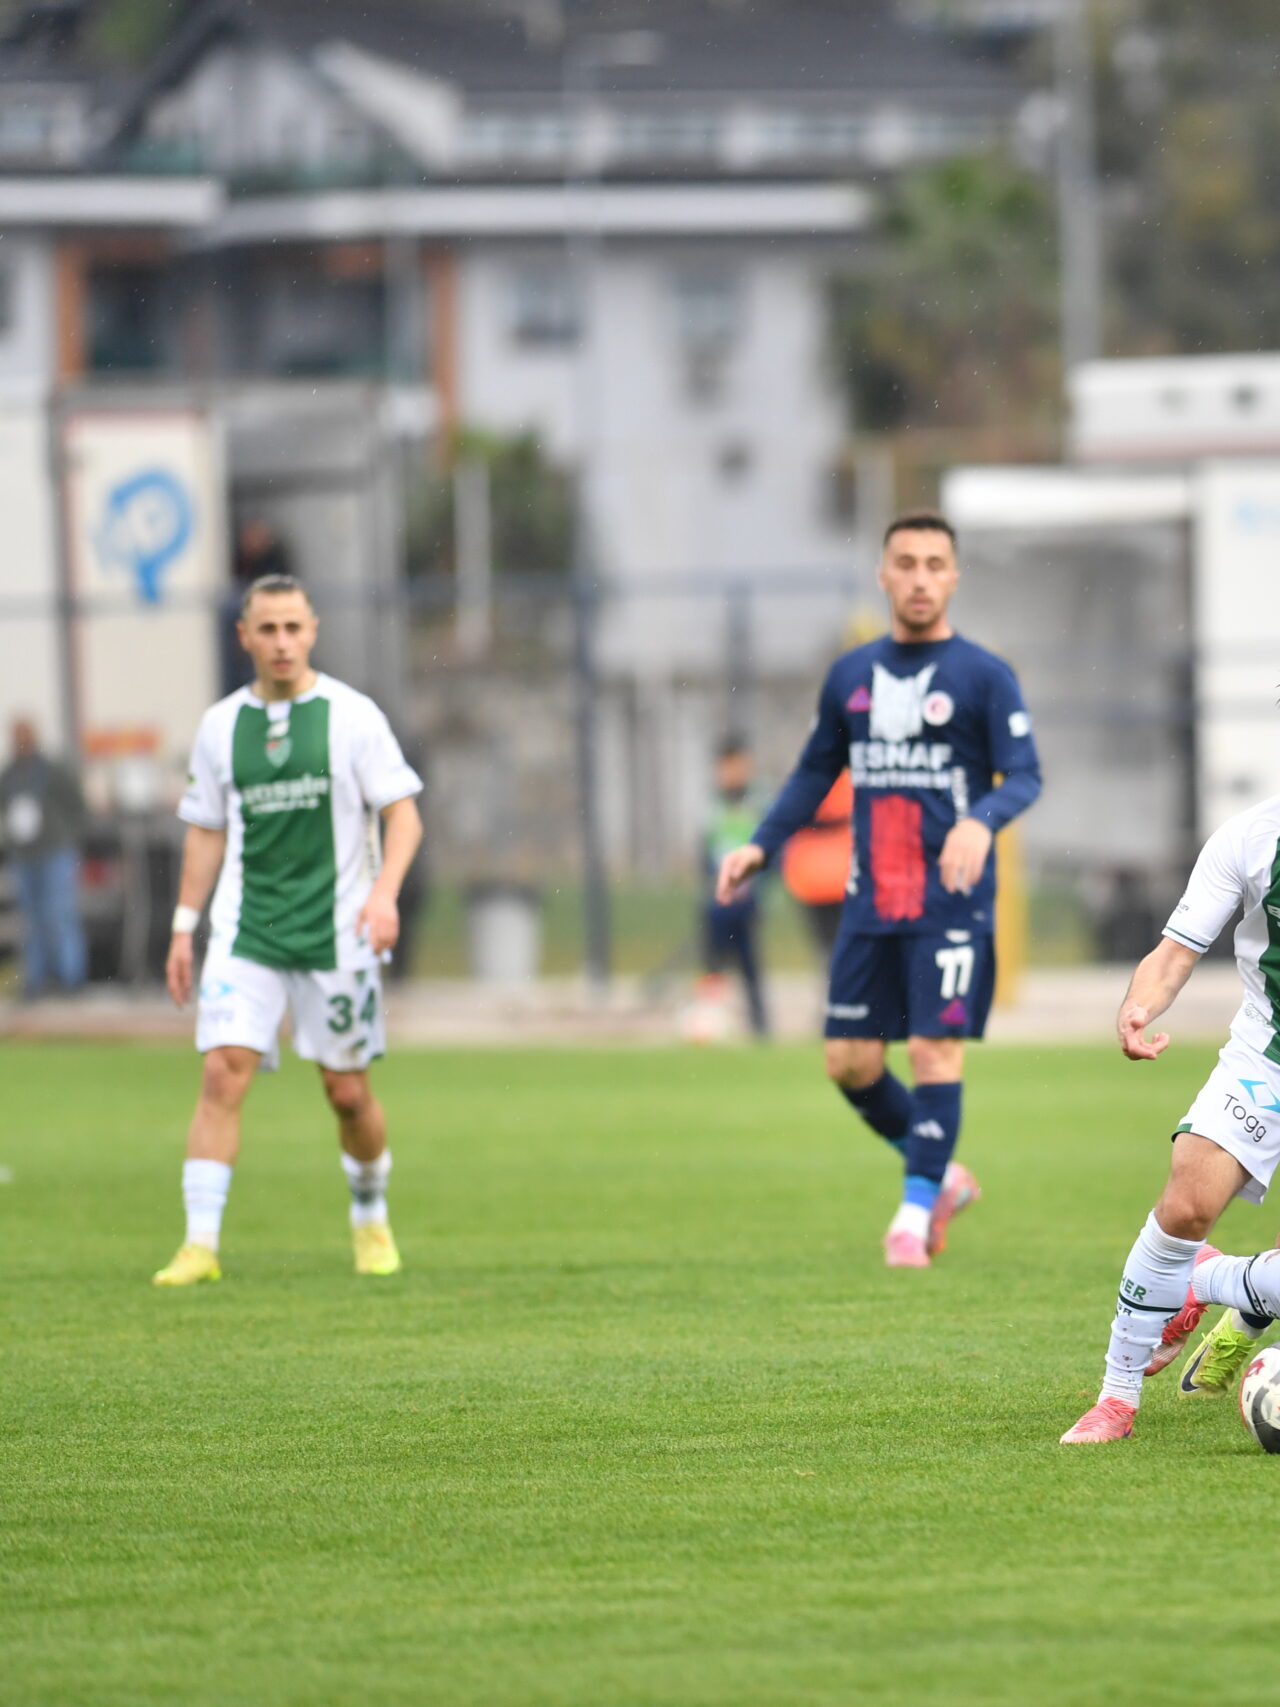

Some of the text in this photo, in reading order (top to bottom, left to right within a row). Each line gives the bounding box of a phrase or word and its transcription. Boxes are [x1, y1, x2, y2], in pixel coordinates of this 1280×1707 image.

[327, 986, 376, 1034] 34
[1225, 1093, 1267, 1143] Togg
[1121, 1276, 1147, 1301] ER
